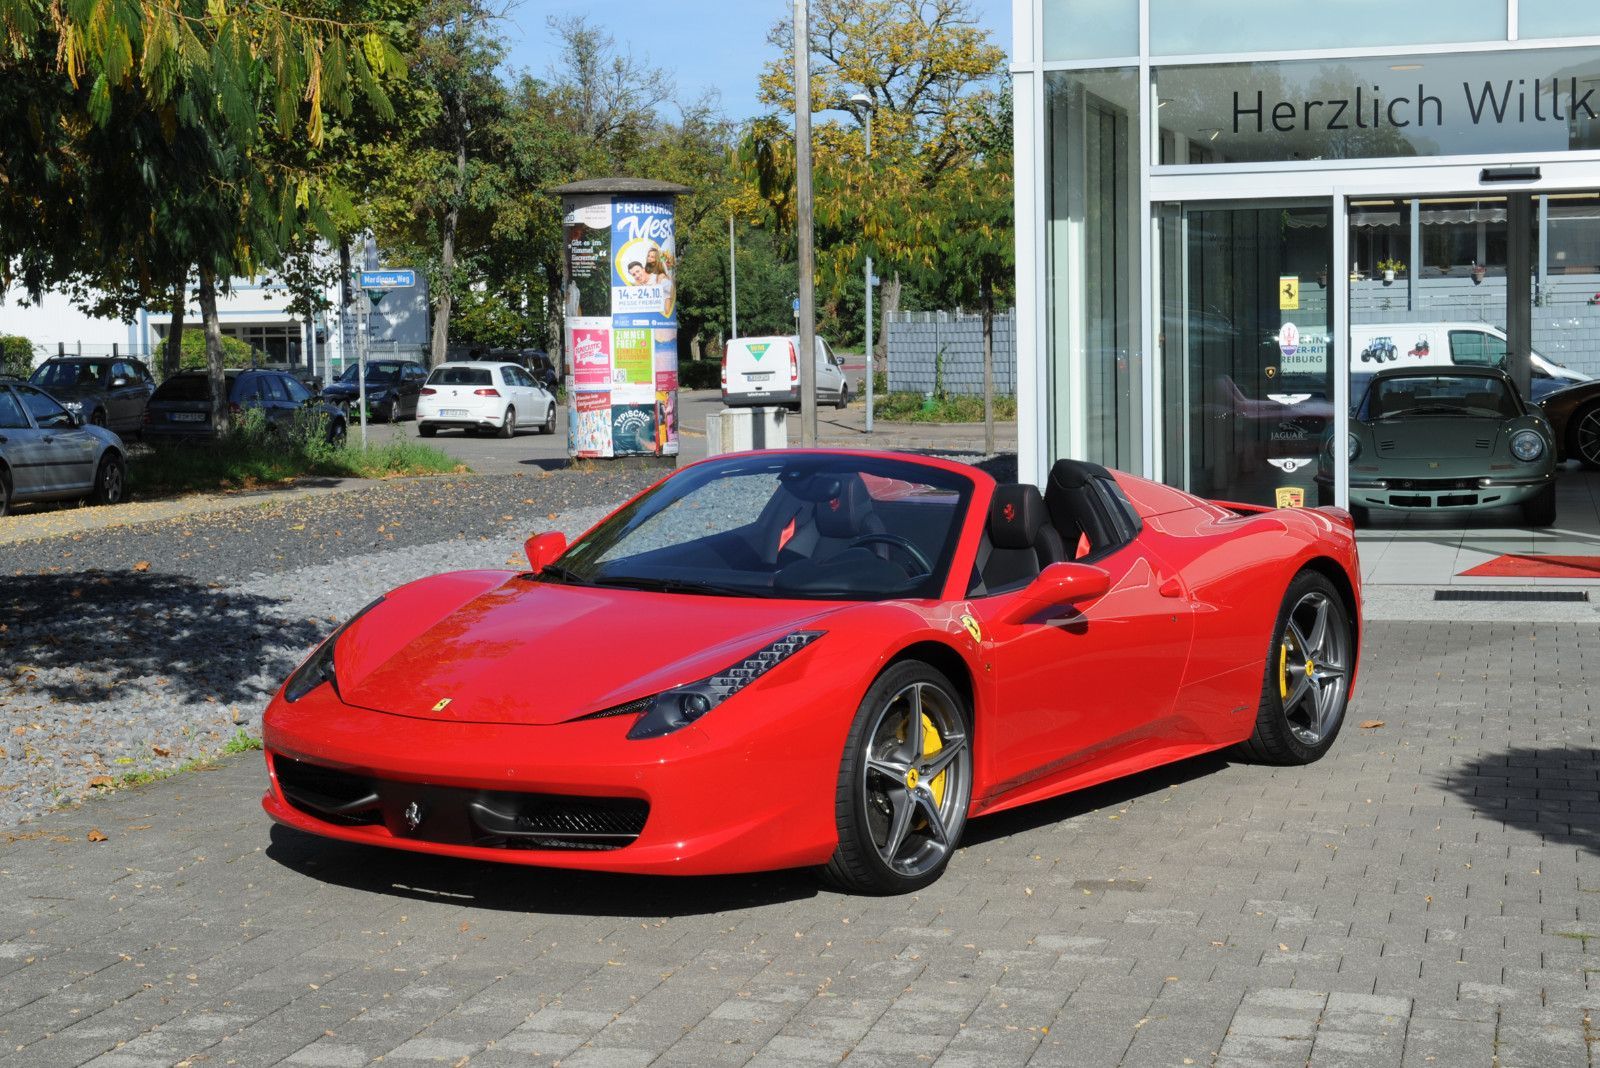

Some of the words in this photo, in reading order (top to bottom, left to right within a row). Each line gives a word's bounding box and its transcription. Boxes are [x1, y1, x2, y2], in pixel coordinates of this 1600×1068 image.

[1232, 83, 1443, 134] Herzlich
[1463, 76, 1600, 126] Willk
[616, 330, 645, 339] ZIMMER
[1270, 431, 1304, 441] JAGUAR
